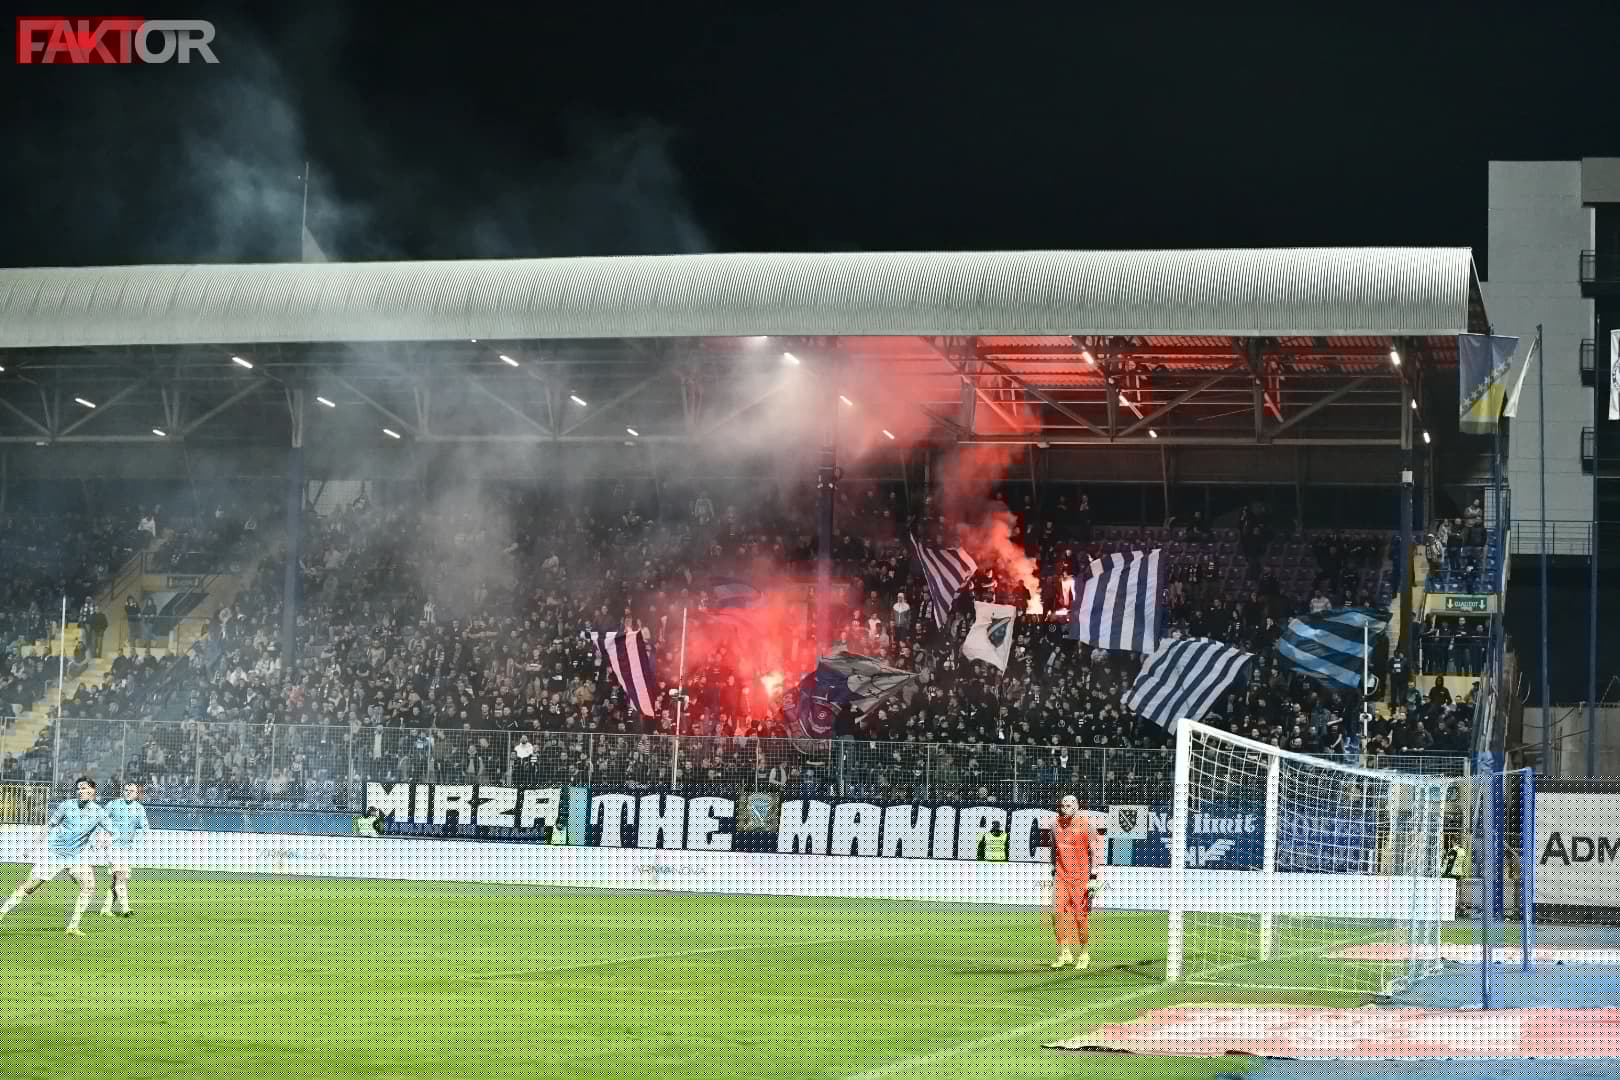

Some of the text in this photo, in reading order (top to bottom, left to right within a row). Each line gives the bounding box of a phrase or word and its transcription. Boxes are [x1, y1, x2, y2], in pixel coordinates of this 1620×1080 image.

[367, 782, 562, 827] MIRZA
[591, 793, 735, 850] THE
[1193, 813, 1257, 834] limit
[1539, 831, 1620, 866] ADM
